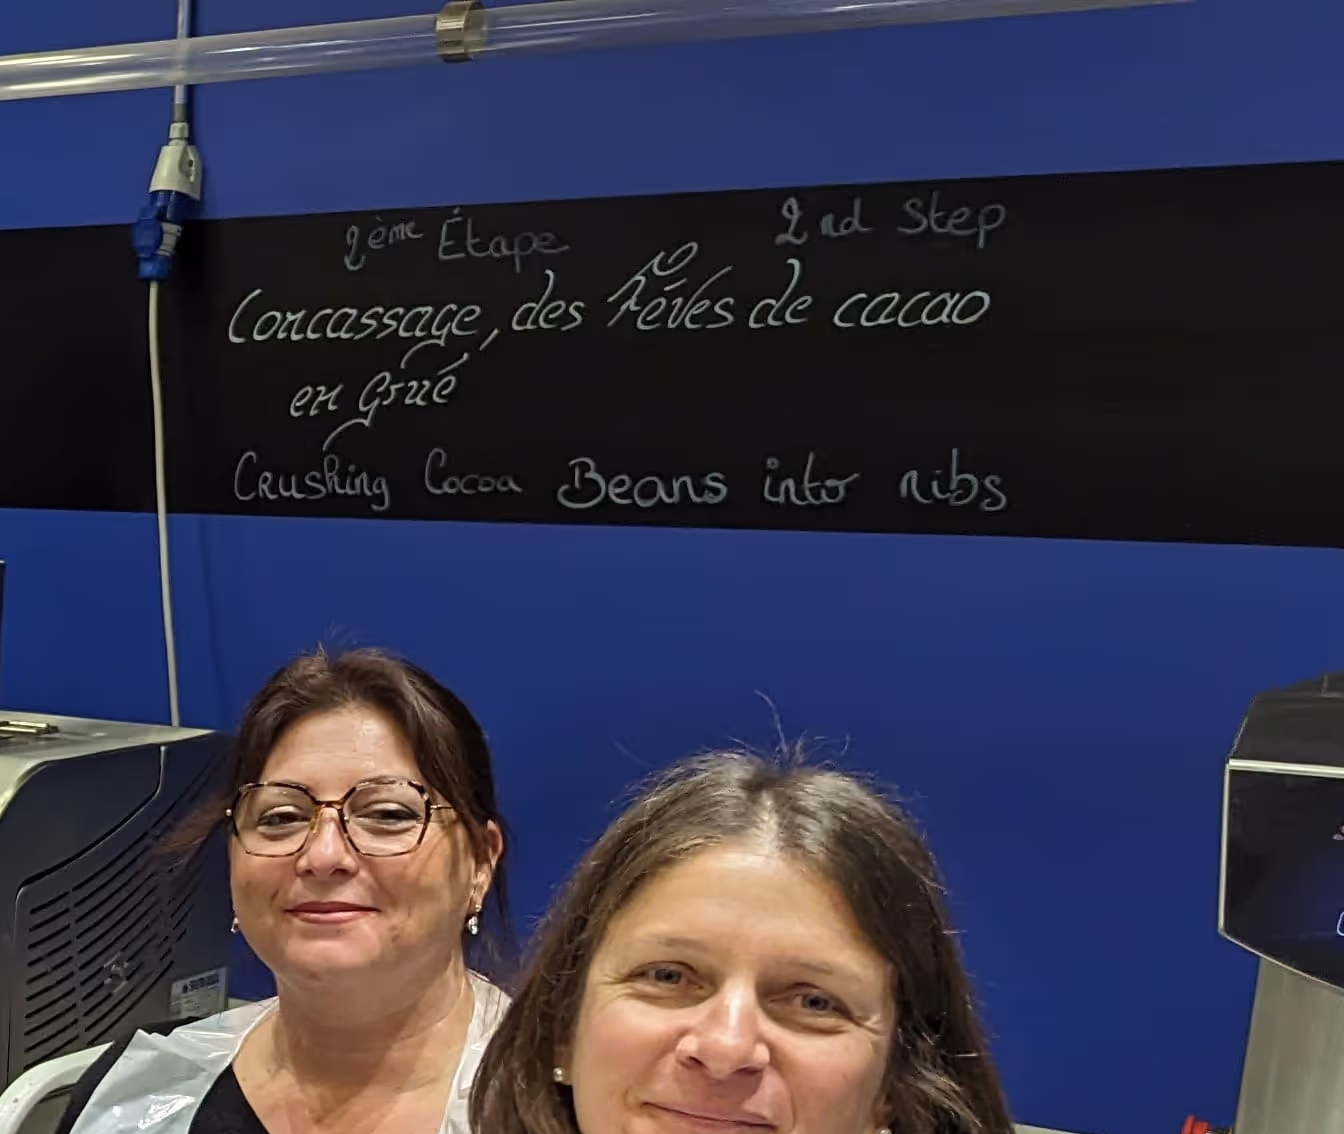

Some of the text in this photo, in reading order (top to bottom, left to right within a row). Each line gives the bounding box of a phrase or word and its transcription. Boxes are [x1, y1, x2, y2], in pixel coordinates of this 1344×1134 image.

[437, 207, 570, 273] Étape
[897, 191, 1008, 249] Step
[511, 269, 586, 332] des
[748, 257, 813, 330] de
[833, 289, 992, 329] cacao
[233, 449, 391, 514] Crushing
[556, 455, 729, 509] Beans
[763, 450, 862, 506] into
